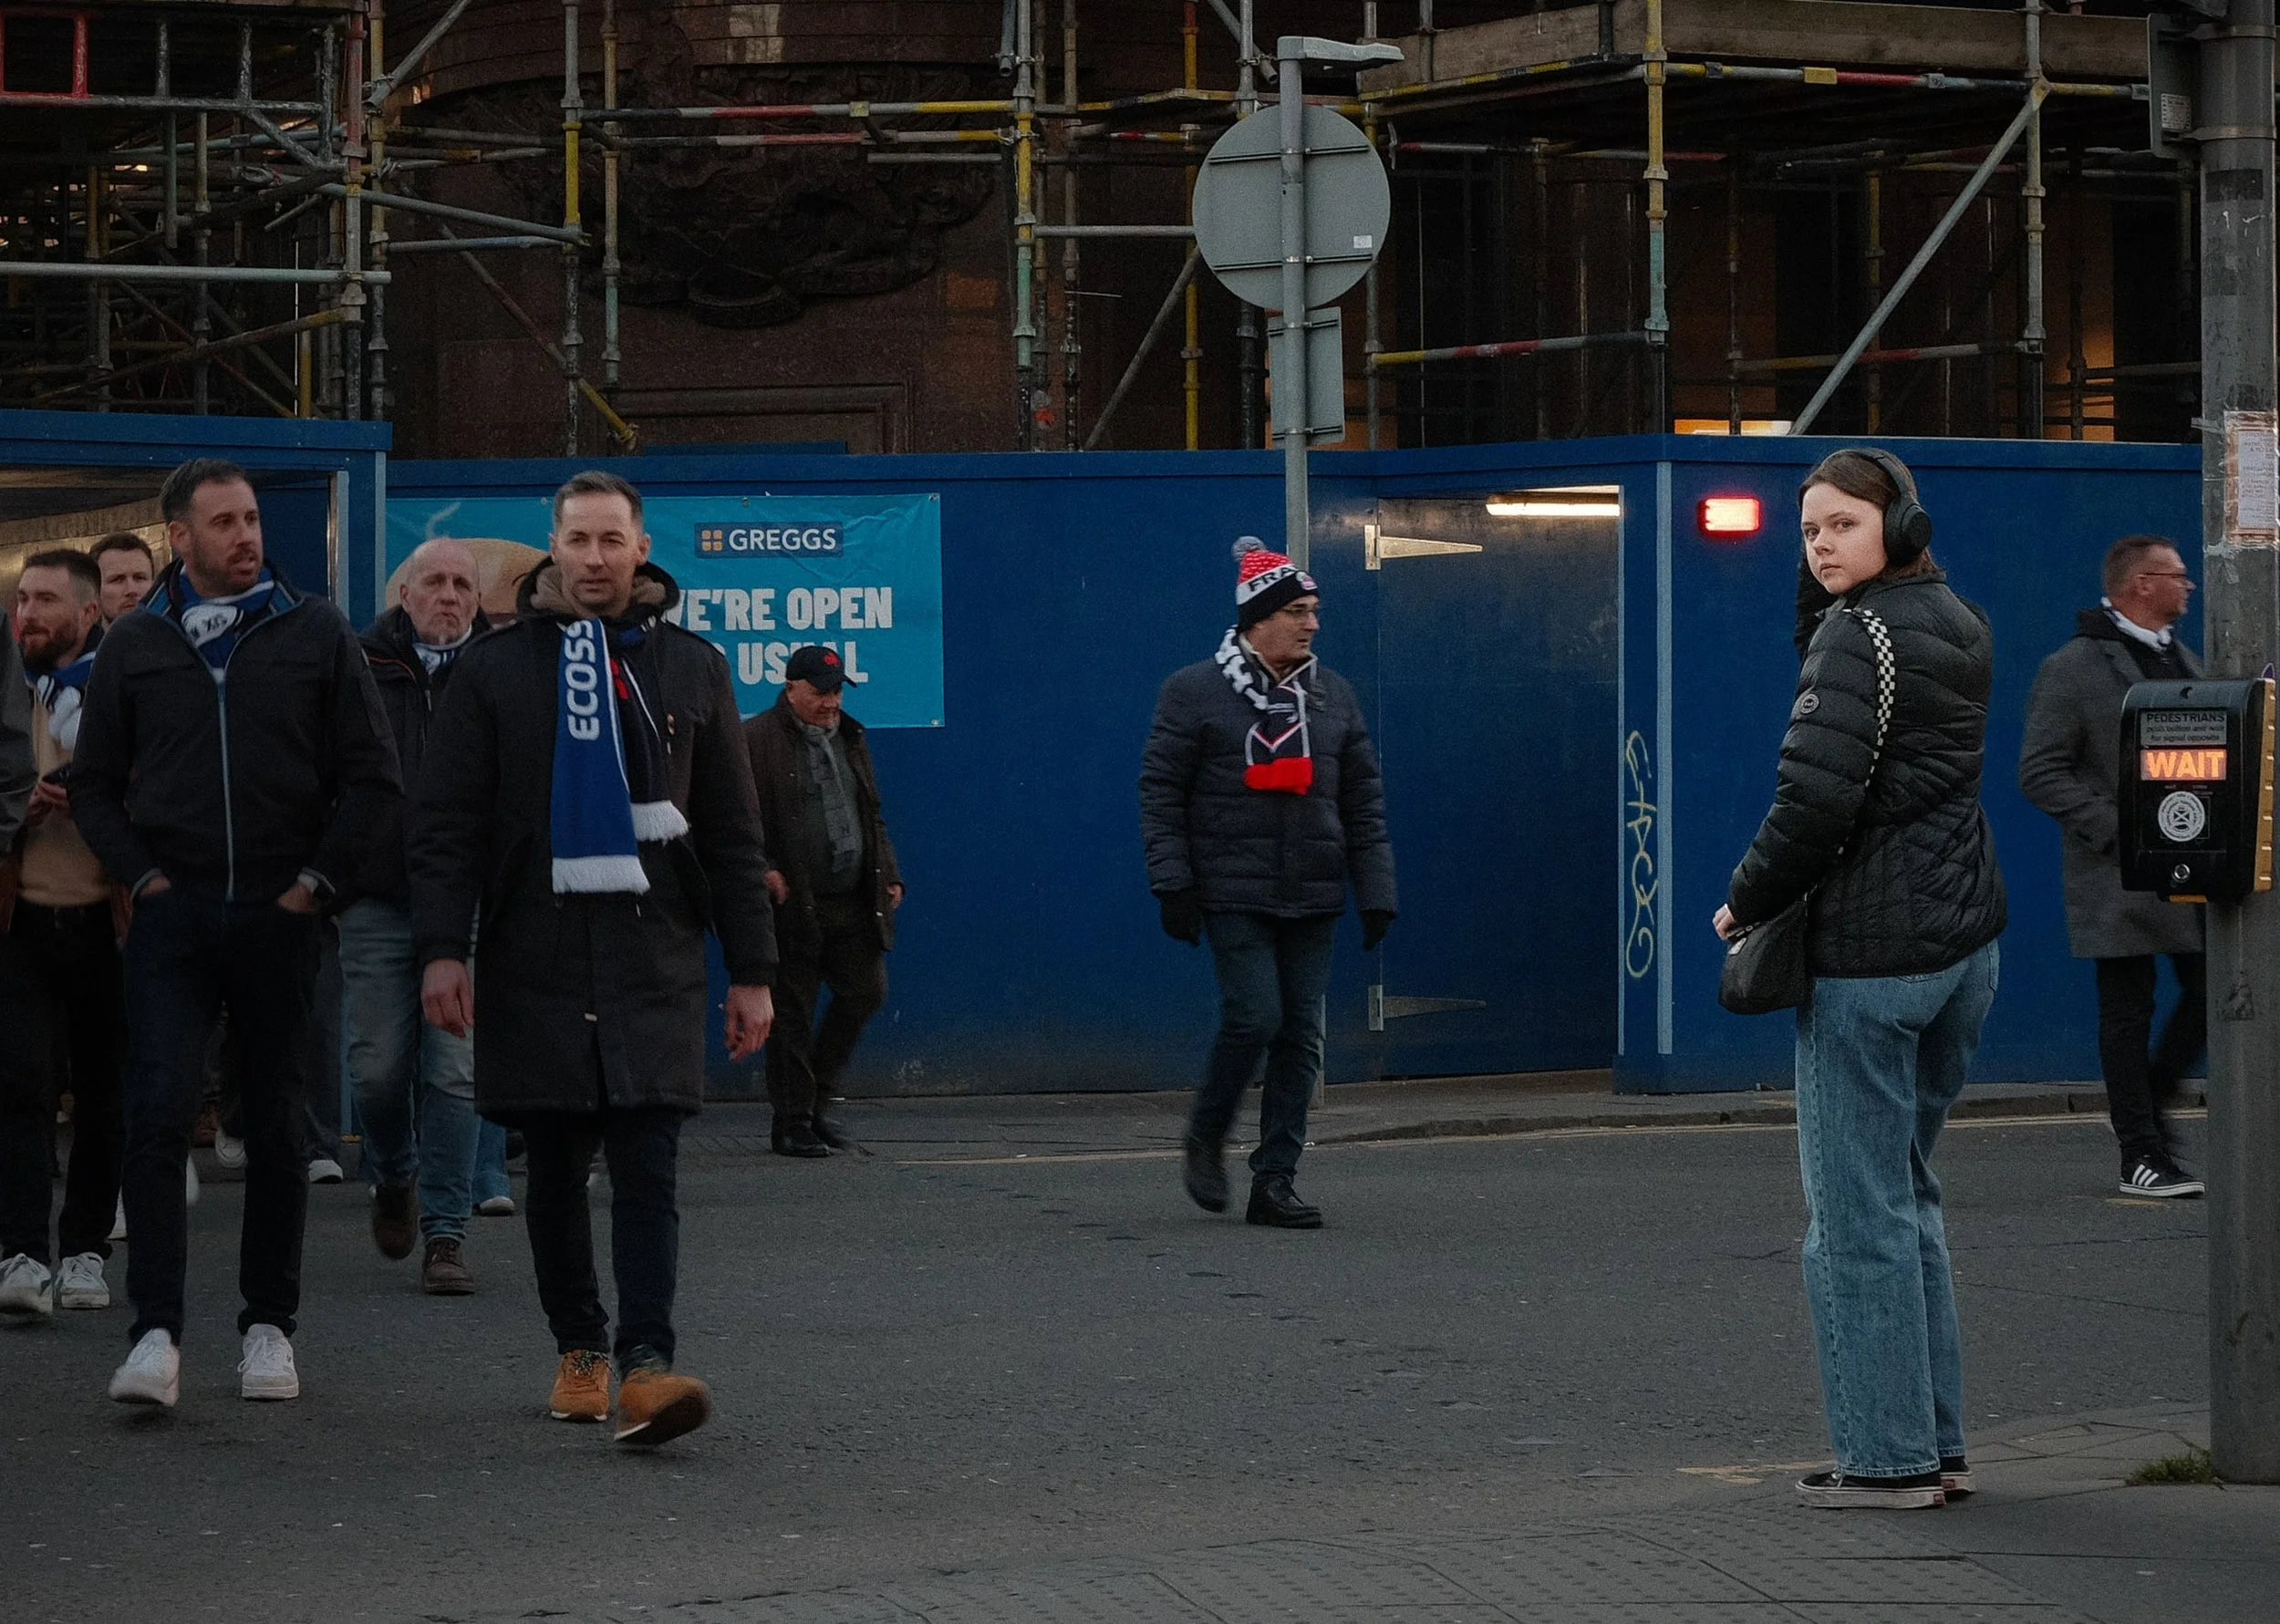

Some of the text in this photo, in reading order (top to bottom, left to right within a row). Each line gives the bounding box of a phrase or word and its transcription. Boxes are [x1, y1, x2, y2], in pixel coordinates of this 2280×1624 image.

[729, 528, 836, 551] GREGGS
[786, 586, 893, 630] OPEN
[737, 641, 868, 685] USL
[2147, 713, 2225, 723] PEDESTRIANS
[2146, 751, 2224, 778] WAIT
